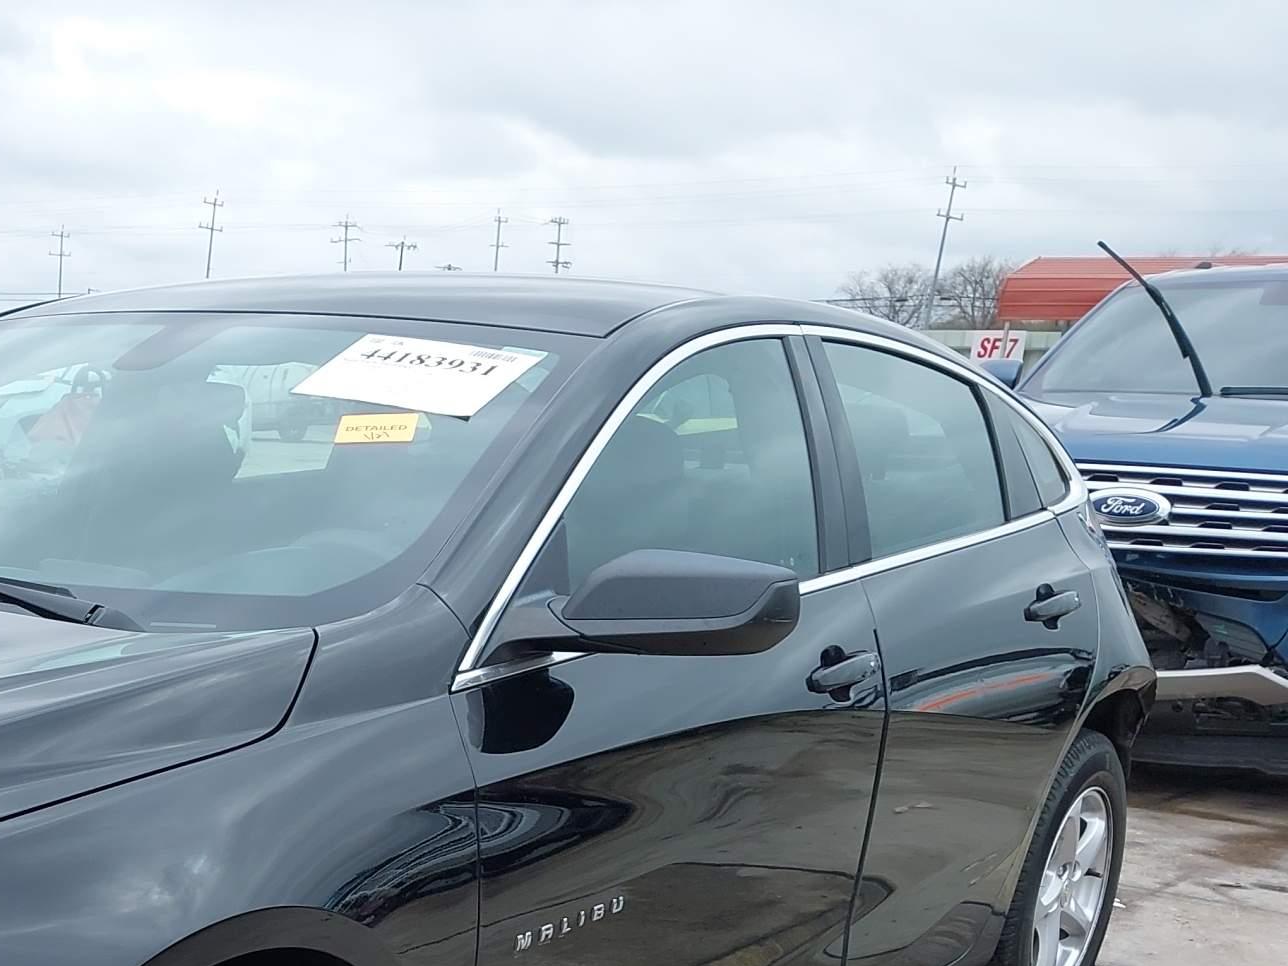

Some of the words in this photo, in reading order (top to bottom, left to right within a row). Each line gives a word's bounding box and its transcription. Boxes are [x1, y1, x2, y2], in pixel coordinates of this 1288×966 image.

[360, 349, 497, 376] 44183931
[345, 424, 408, 432] DETAILED
[1101, 497, 1145, 514] Ford
[515, 896, 624, 953] MALIBU
